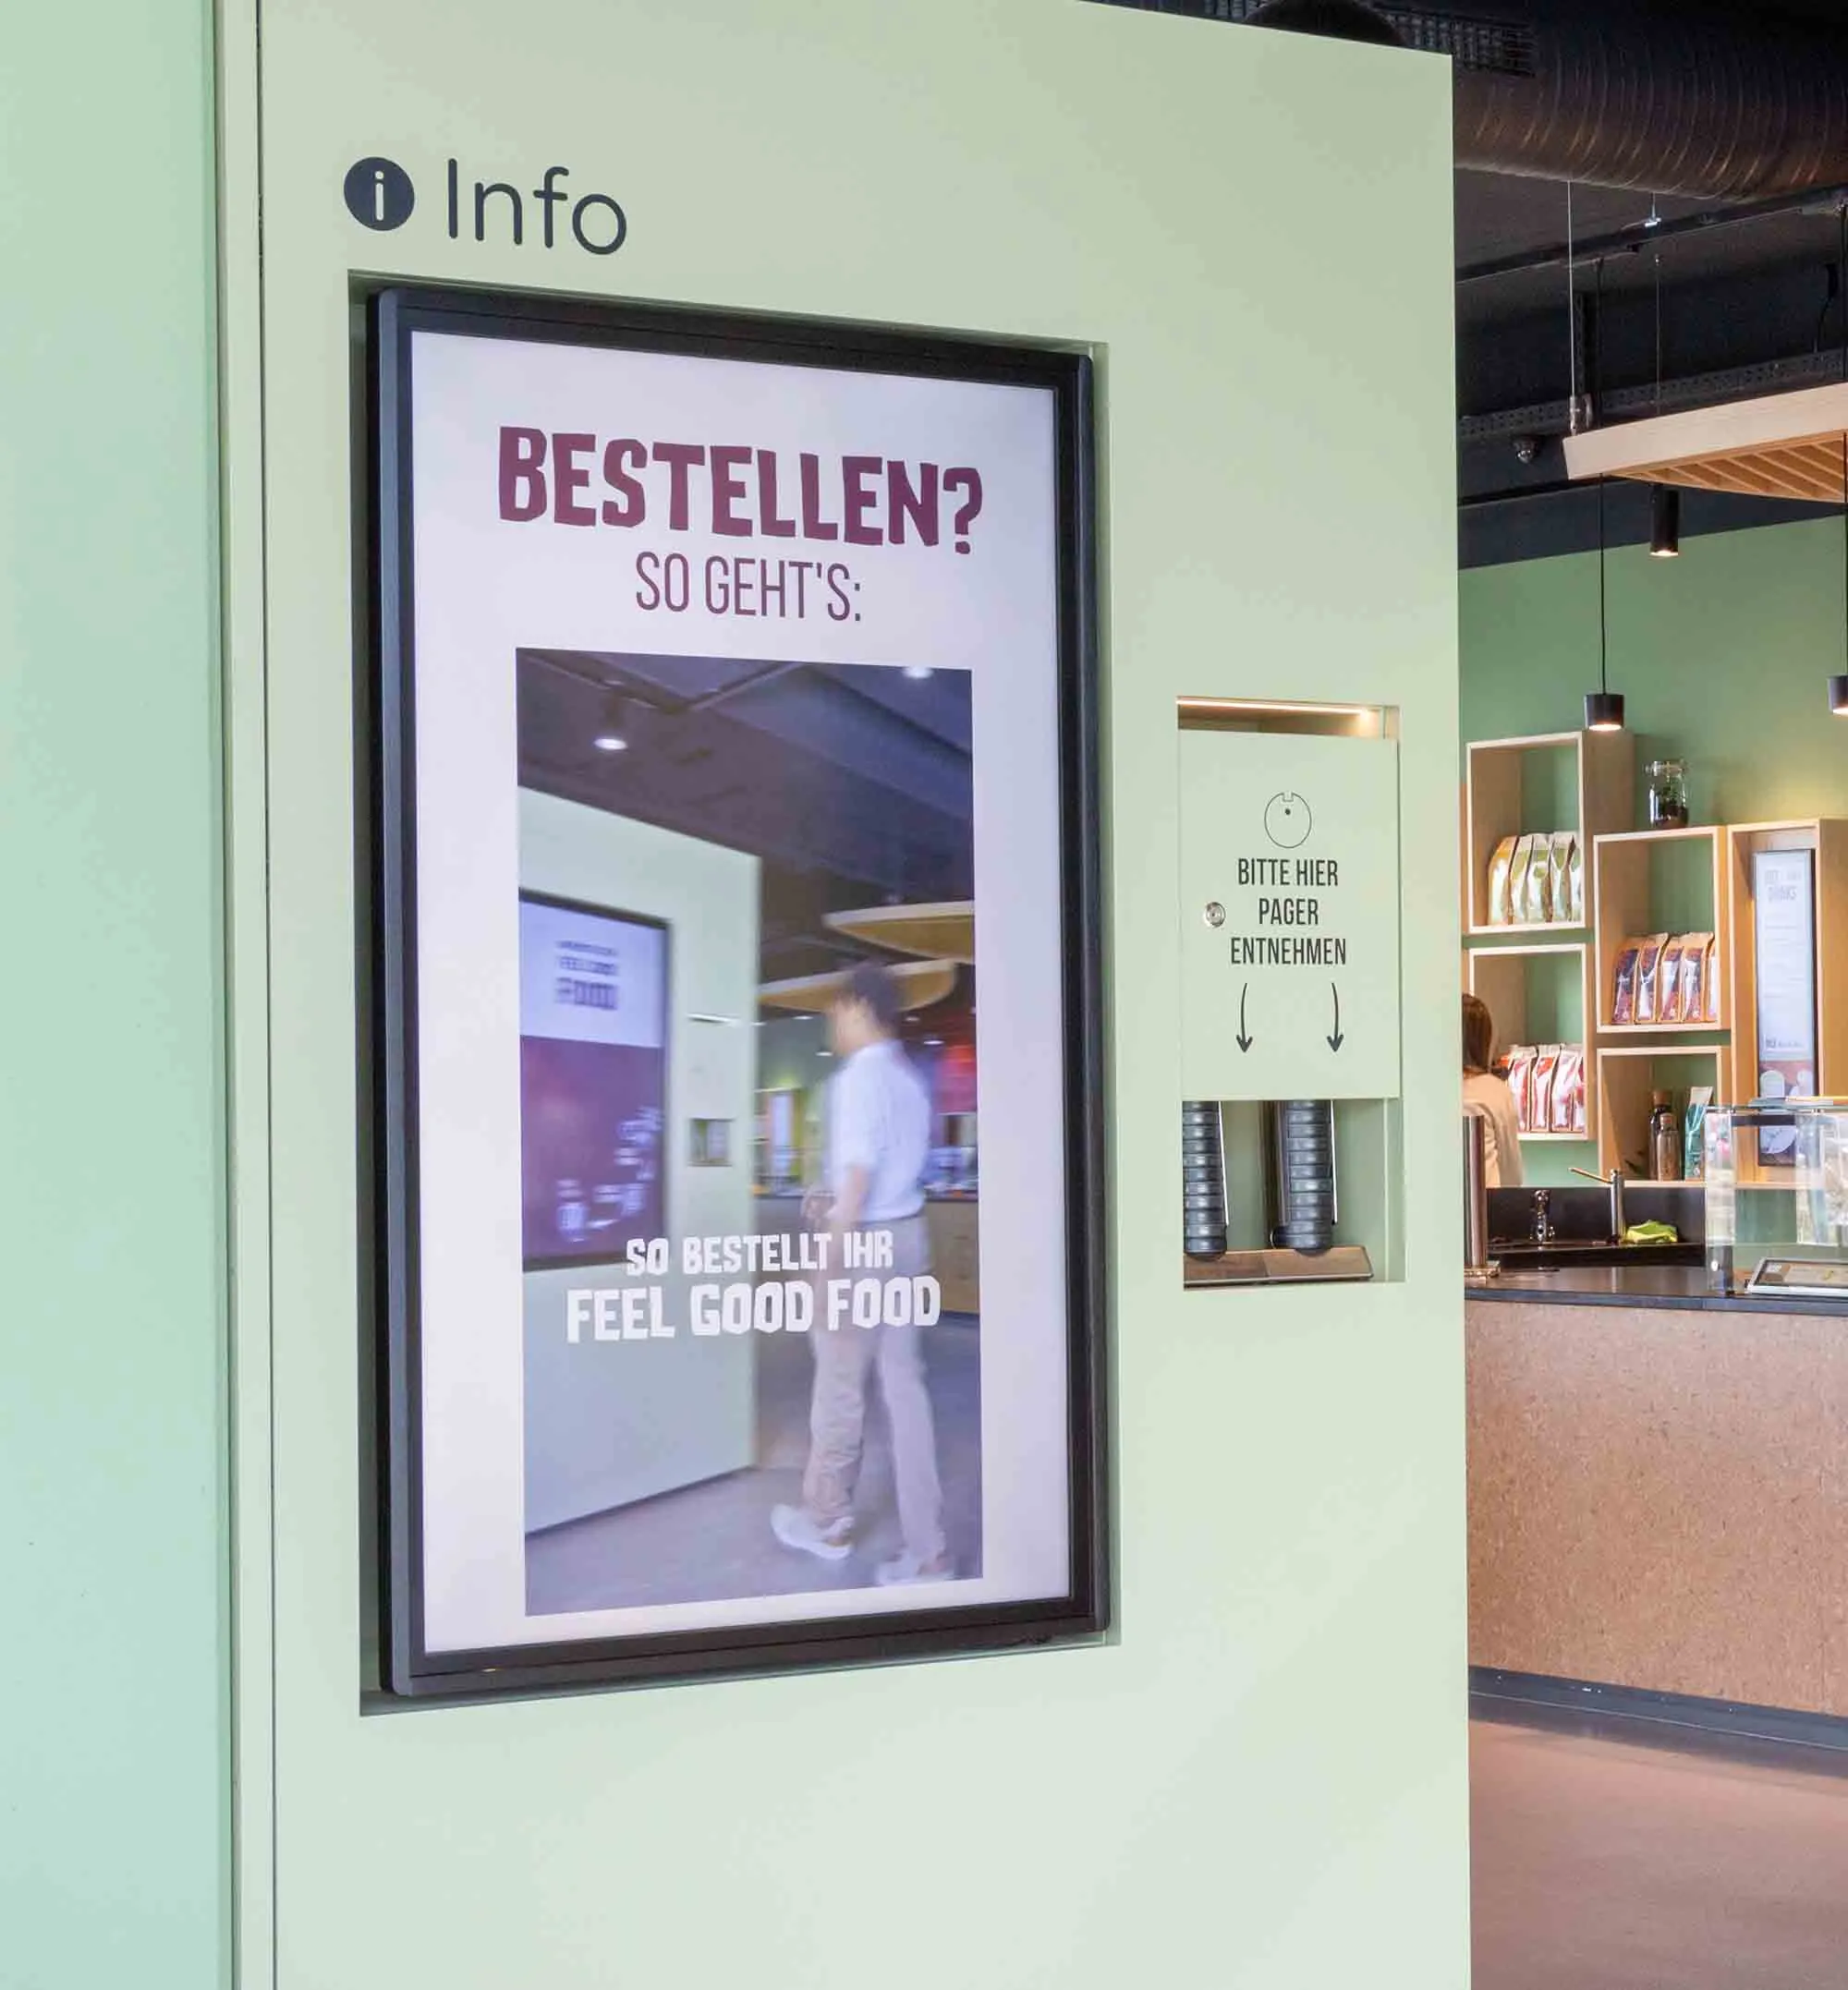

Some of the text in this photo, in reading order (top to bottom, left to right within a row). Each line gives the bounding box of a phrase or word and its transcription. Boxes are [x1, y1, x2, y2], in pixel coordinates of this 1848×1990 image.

[447, 158, 627, 255] Info
[498, 426, 983, 556] BESTELLEN?
[636, 552, 862, 623] SO GEHT'S:
[1237, 858, 1339, 887] BITTE HIER
[1258, 898, 1319, 926] PAGER
[1231, 937, 1346, 965] ENTNEHMEN
[626, 1230, 894, 1277] SO BESTELLT IHR
[566, 1275, 942, 1343] FEEL GOOD FOOD
